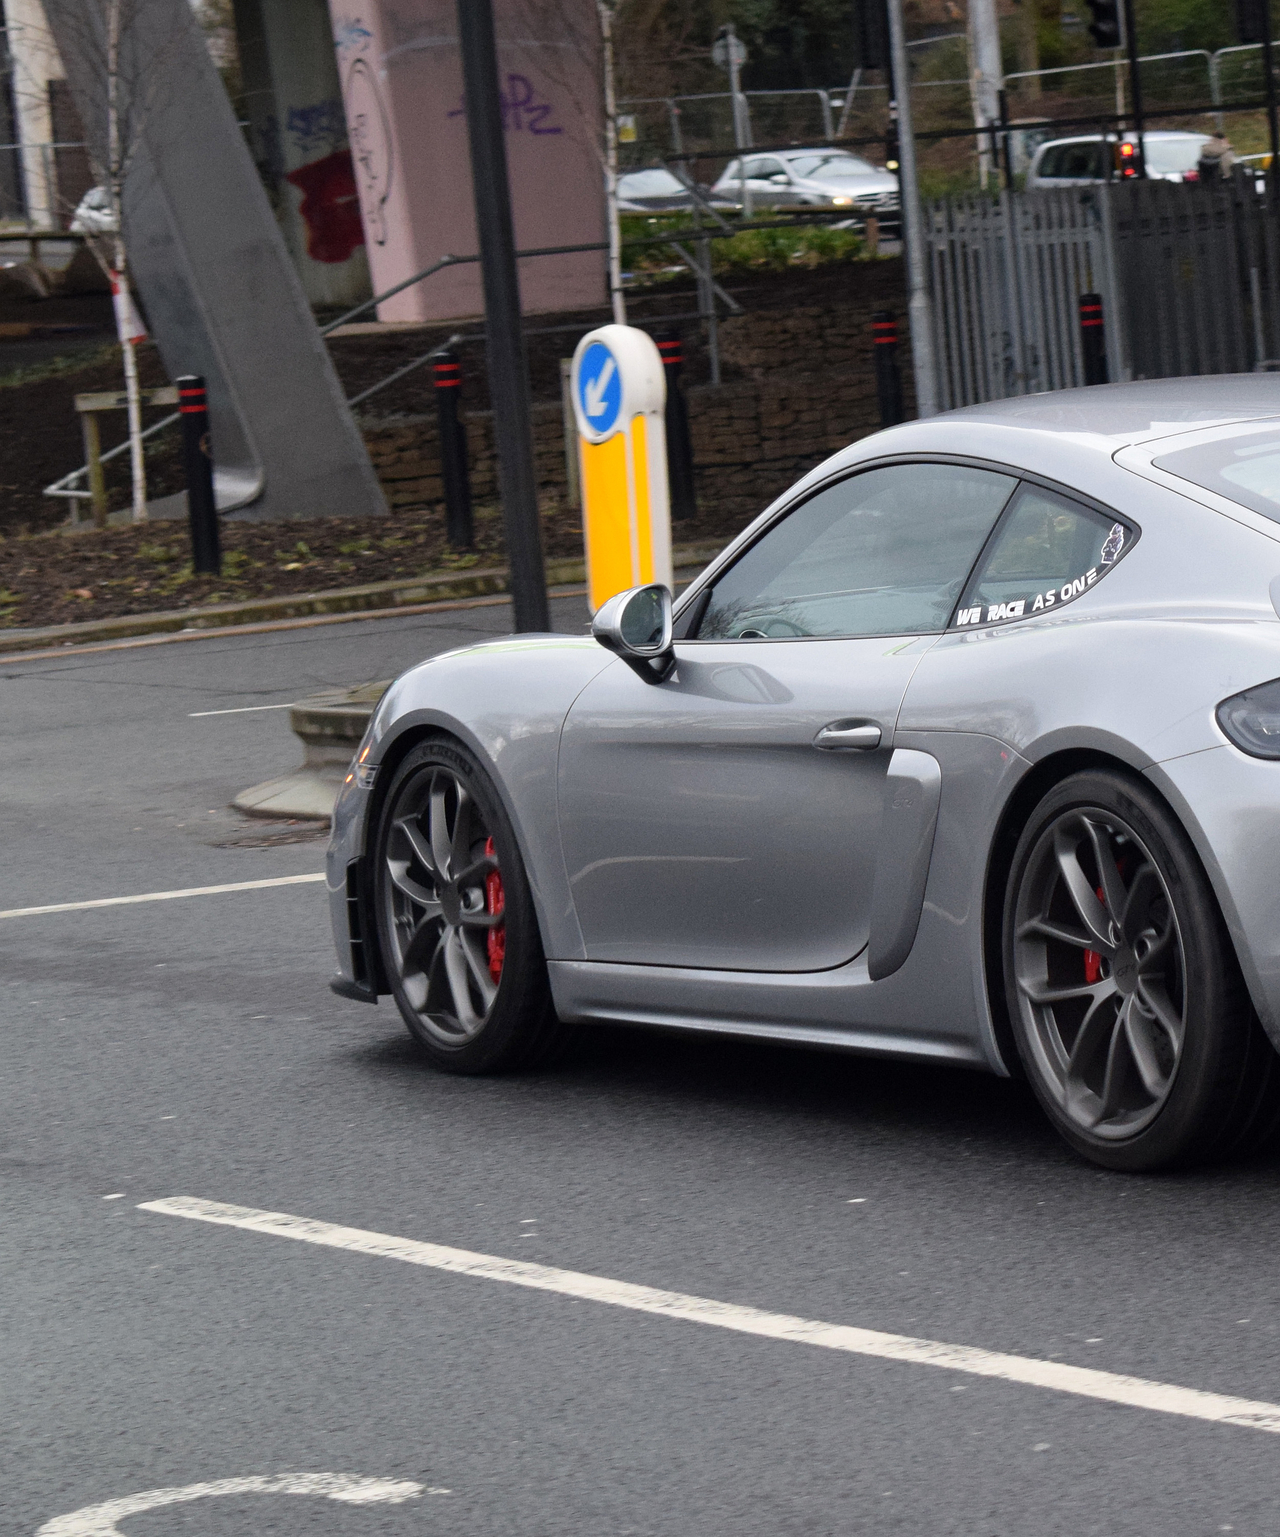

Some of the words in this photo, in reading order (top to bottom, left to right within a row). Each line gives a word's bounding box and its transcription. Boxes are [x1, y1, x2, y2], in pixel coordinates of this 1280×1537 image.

[957, 606, 982, 625] WE
[987, 600, 1026, 621] RACE
[1032, 589, 1056, 611] AS
[1060, 567, 1098, 600] ONE
